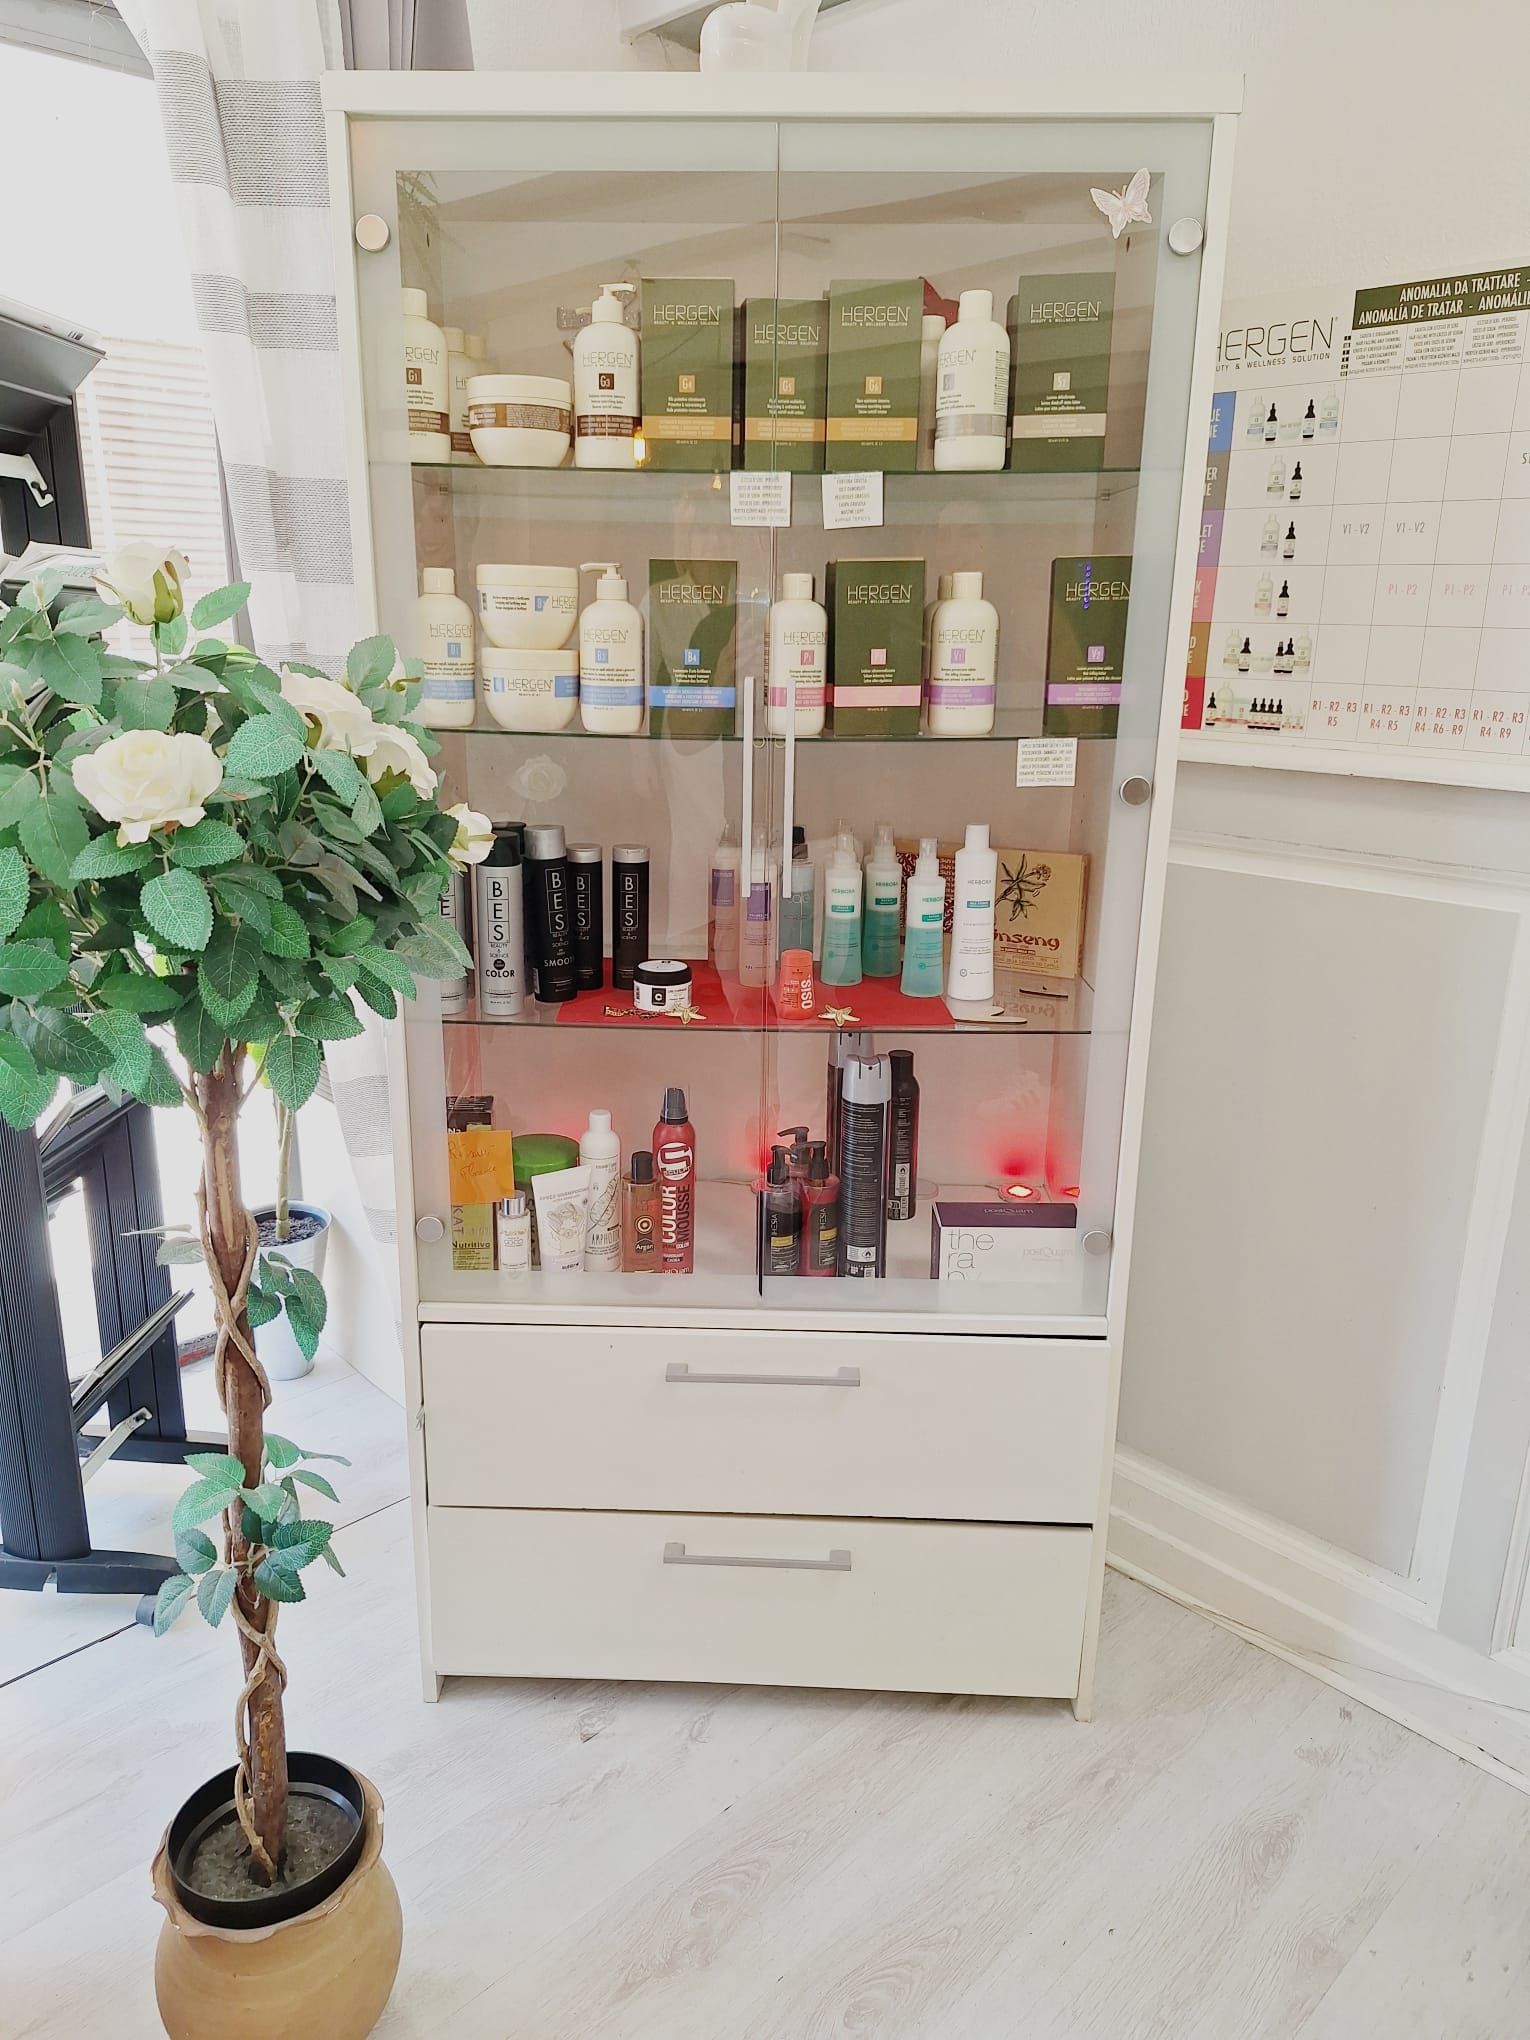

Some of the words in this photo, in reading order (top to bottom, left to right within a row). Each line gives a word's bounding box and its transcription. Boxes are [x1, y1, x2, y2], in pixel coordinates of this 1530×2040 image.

[1400, 282, 1451, 302] ANOMALIA
[1454, 280, 1469, 295] DA
[1471, 272, 1521, 292] TRATTARE
[653, 304, 720, 321] HERGEN
[841, 306, 909, 322] HERGEN
[1030, 301, 1100, 319] HERGEN
[1358, 303, 1408, 325] ANOMALÍA
[1411, 304, 1425, 318] DE
[1427, 299, 1463, 317] TRATAR
[754, 324, 819, 341] HERGEN
[583, 352, 632, 366] HERGEN
[1246, 357, 1286, 368] WELLNESS
[1292, 352, 1330, 364] SOLUTION
[1343, 524, 1351, 534] V1
[1360, 523, 1370, 534] V2
[1396, 522, 1405, 533] V1
[1415, 522, 1425, 533] V2
[660, 584, 723, 600] HERGEN
[847, 585, 911, 600] HERGEN
[938, 629, 984, 641] HERGEN
[508, 679, 552, 690] HERGEN
[1313, 701, 1321, 710] R1
[1329, 701, 1339, 711] R2
[1346, 702, 1357, 713] R3
[1364, 703, 1373, 714] R1
[1381, 704, 1392, 715] R2
[1400, 706, 1410, 716] R3
[1417, 707, 1427, 717] R1
[1436, 708, 1447, 718] R2
[1455, 708, 1465, 720] R3
[1328, 716, 1337, 726] R5
[1473, 709, 1483, 720] R1
[1493, 711, 1504, 722] R2
[1513, 713, 1524, 724] R3
[1370, 719, 1380, 729] R4
[1388, 720, 1398, 730] R5
[1414, 722, 1425, 733] R4
[1433, 723, 1444, 734] R6
[1452, 725, 1463, 735] R9
[1480, 726, 1491, 737] R4
[1499, 728, 1511, 739] R9
[485, 969, 515, 978] COLOR
[677, 1183, 690, 1242] MOUSSE
[948, 1227, 994, 1251] the
[635, 1243, 654, 1252] Argan
[948, 1252, 975, 1269] ra
